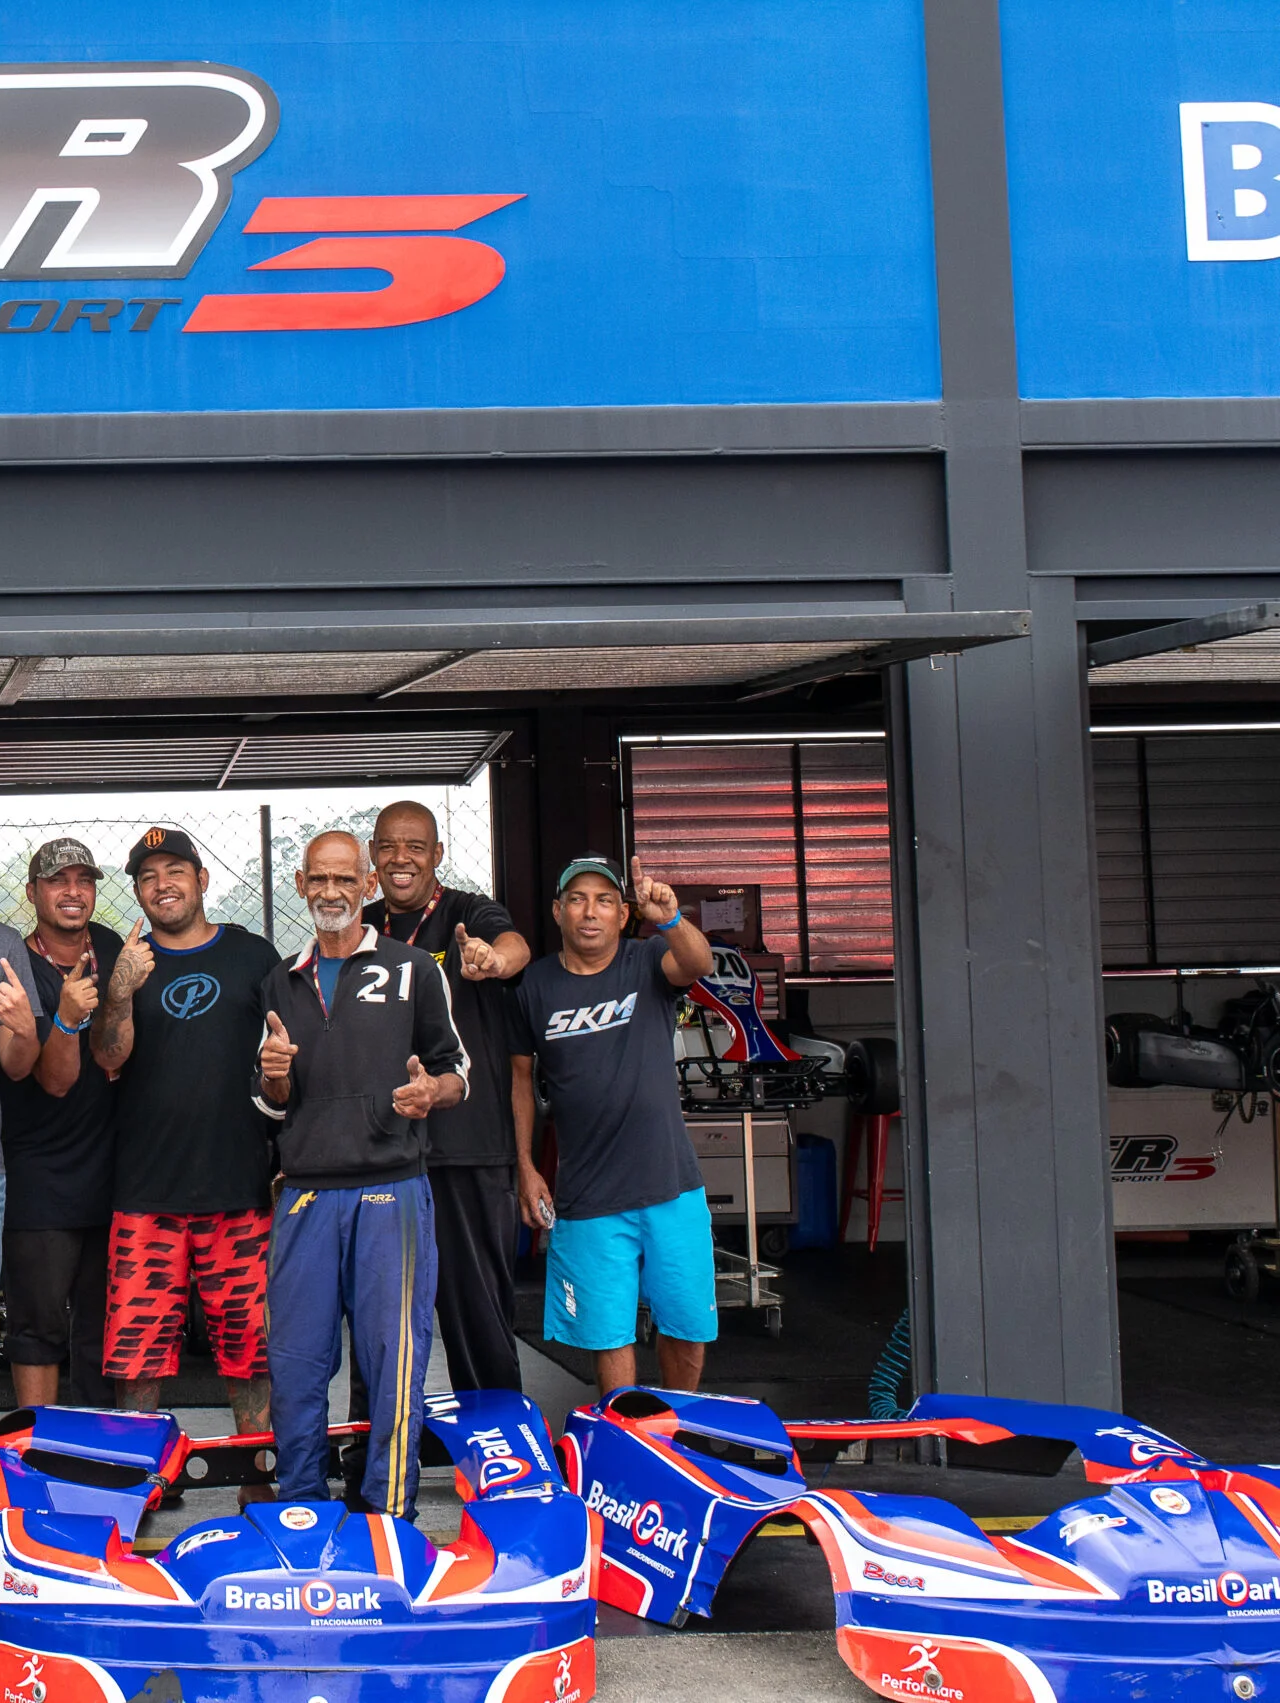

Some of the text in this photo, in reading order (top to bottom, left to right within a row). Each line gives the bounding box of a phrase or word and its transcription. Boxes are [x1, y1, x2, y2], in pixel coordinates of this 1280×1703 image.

[357, 961, 412, 1003] 21
[545, 992, 637, 1035] SKM
[1111, 1175, 1163, 1183] SPORT
[310, 1619, 383, 1627] ESTACIONAMENTOS
